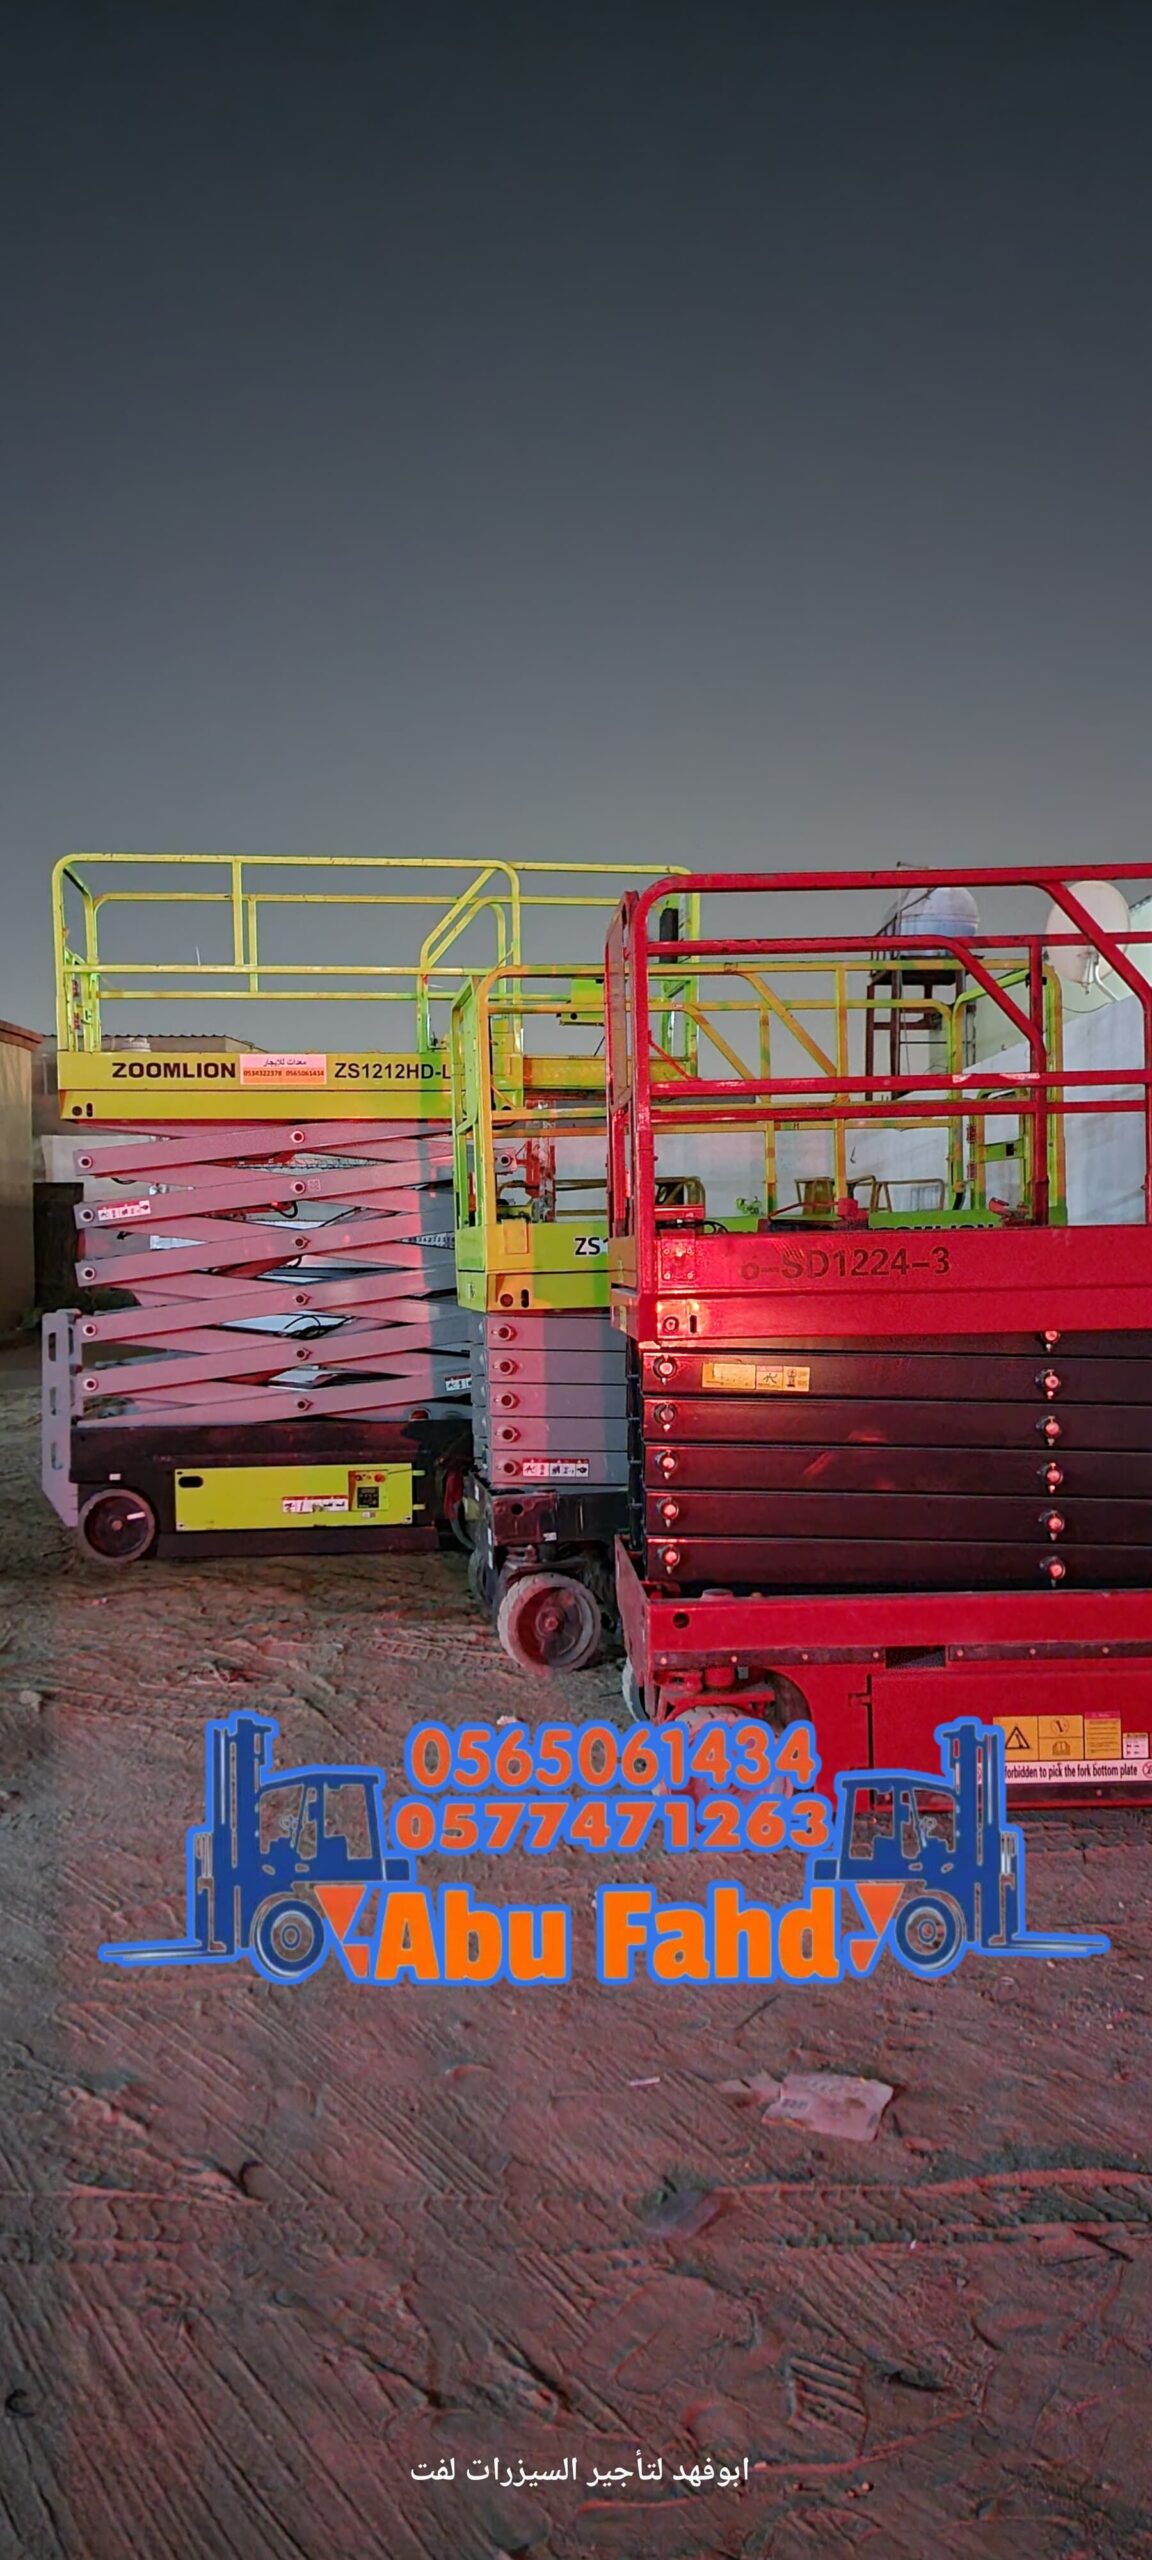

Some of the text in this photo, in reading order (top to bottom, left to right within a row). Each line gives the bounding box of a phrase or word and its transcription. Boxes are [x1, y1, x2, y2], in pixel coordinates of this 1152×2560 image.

[112, 1062, 236, 1078] ZOOMLION
[574, 1236, 608, 1256] ZS
[1039, 1766, 1047, 1778] to
[1064, 1764, 1076, 1777] the
[1077, 1763, 1091, 1777] fork
[1092, 1763, 1118, 1776] bottom
[1120, 1763, 1138, 1779] plate
